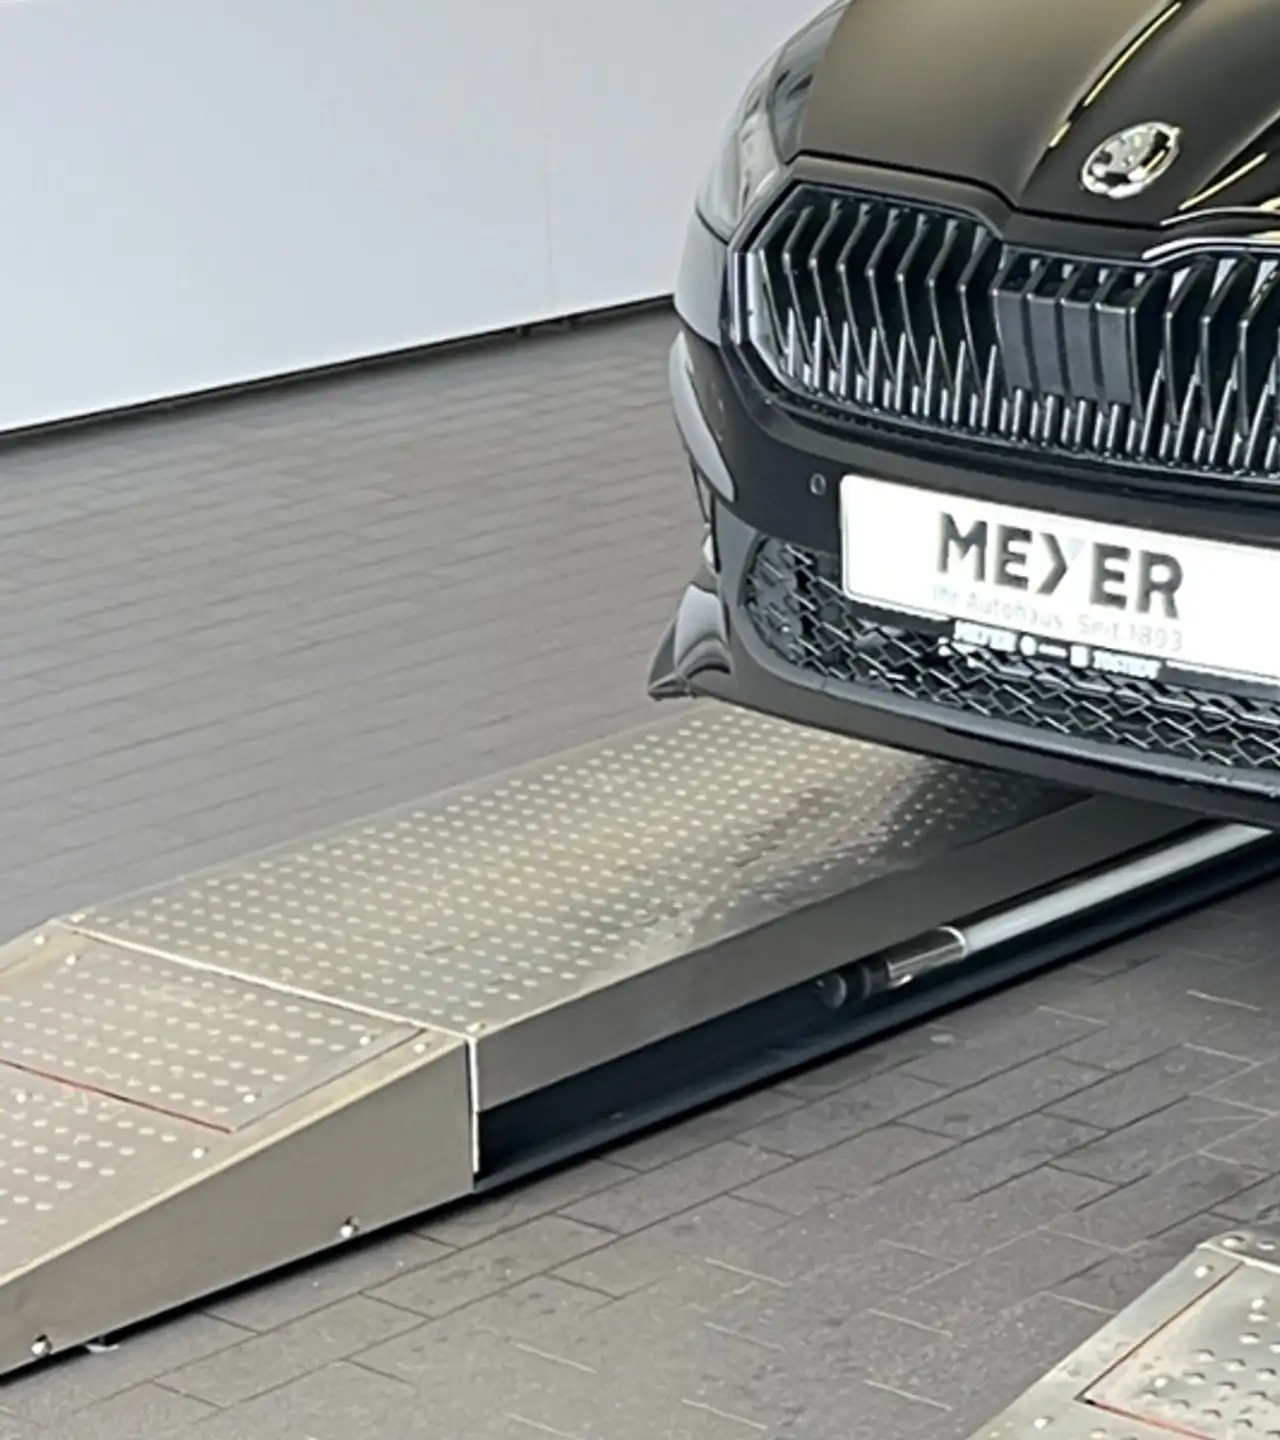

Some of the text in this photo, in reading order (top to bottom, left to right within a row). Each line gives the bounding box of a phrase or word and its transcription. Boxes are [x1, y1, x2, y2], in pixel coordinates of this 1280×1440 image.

[936, 511, 1184, 620] MEYER
[1078, 615, 1120, 639] Seit
[1128, 623, 1184, 653] 1893
